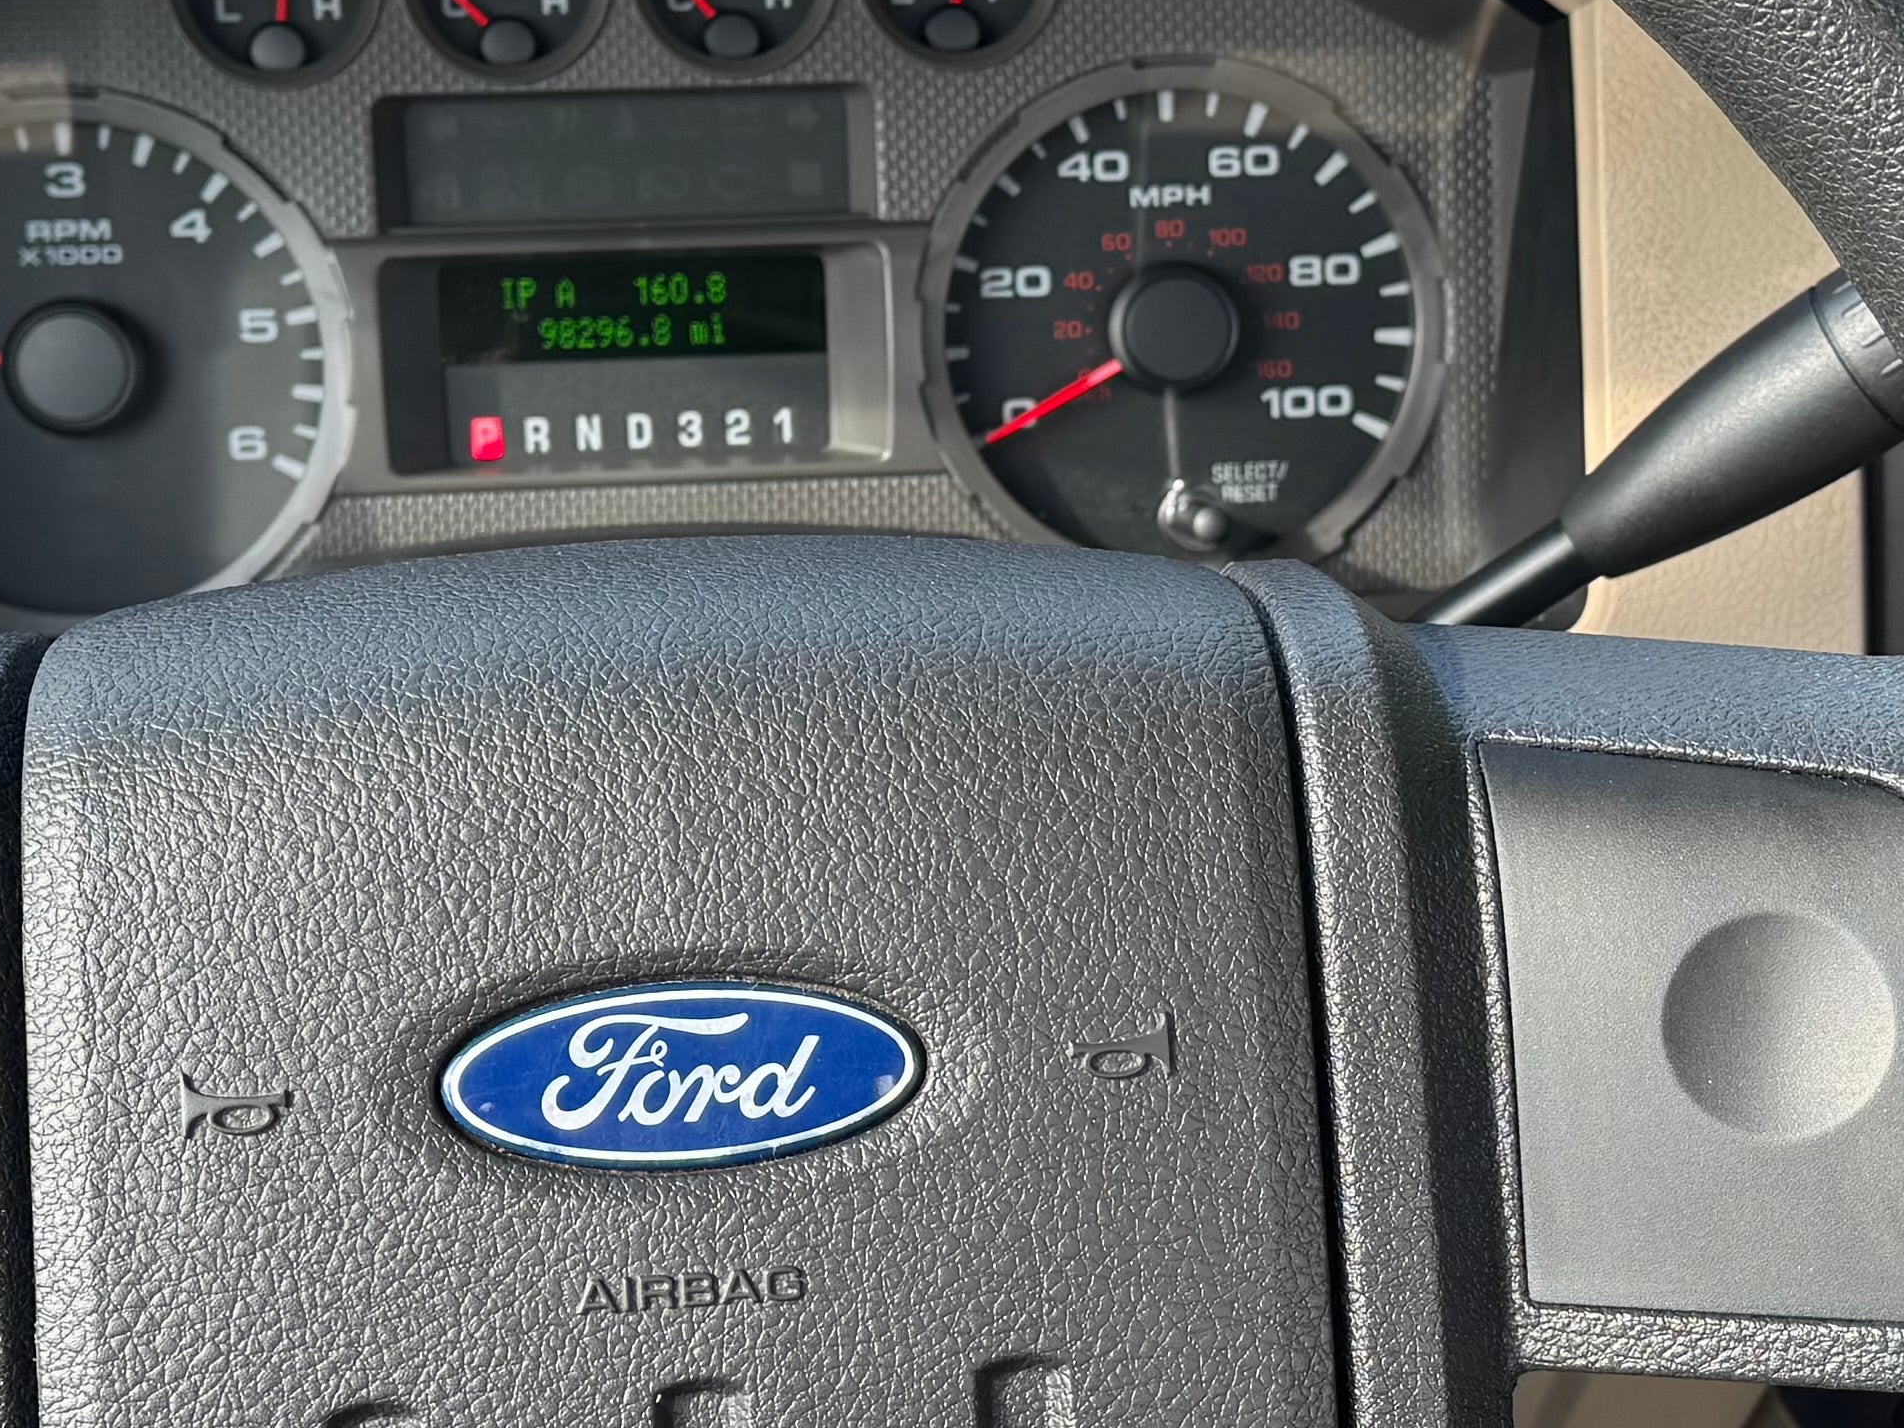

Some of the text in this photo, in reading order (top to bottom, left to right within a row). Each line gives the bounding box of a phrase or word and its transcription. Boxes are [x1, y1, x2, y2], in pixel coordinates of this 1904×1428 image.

[1058, 149, 1129, 182] 40
[1207, 145, 1280, 178] 60
[45, 162, 86, 198] 3
[1129, 185, 1211, 208] MPH
[26, 219, 112, 242] RPM
[170, 209, 212, 243] 4
[1101, 232, 1132, 252] 60
[1155, 220, 1184, 240] 80
[1209, 228, 1247, 248] 100
[980, 266, 1051, 298] 20
[1063, 272, 1094, 291] 40
[1288, 254, 1360, 287] 80
[555, 279, 576, 308] A
[633, 271, 728, 306] 160.8
[239, 309, 279, 343] 5
[690, 313, 725, 345] mi
[1053, 321, 1084, 339] 20
[1260, 386, 1353, 419] 100
[228, 427, 267, 461] 6
[524, 416, 550, 454] R
[576, 414, 603, 452] N
[627, 412, 653, 450] D
[678, 410, 703, 448] 3
[725, 409, 752, 446] 2
[774, 407, 793, 444] 1
[1221, 483, 1278, 503] RESET
[541, 1010, 821, 1132] Ford
[575, 1265, 808, 1318] AIRBAG
